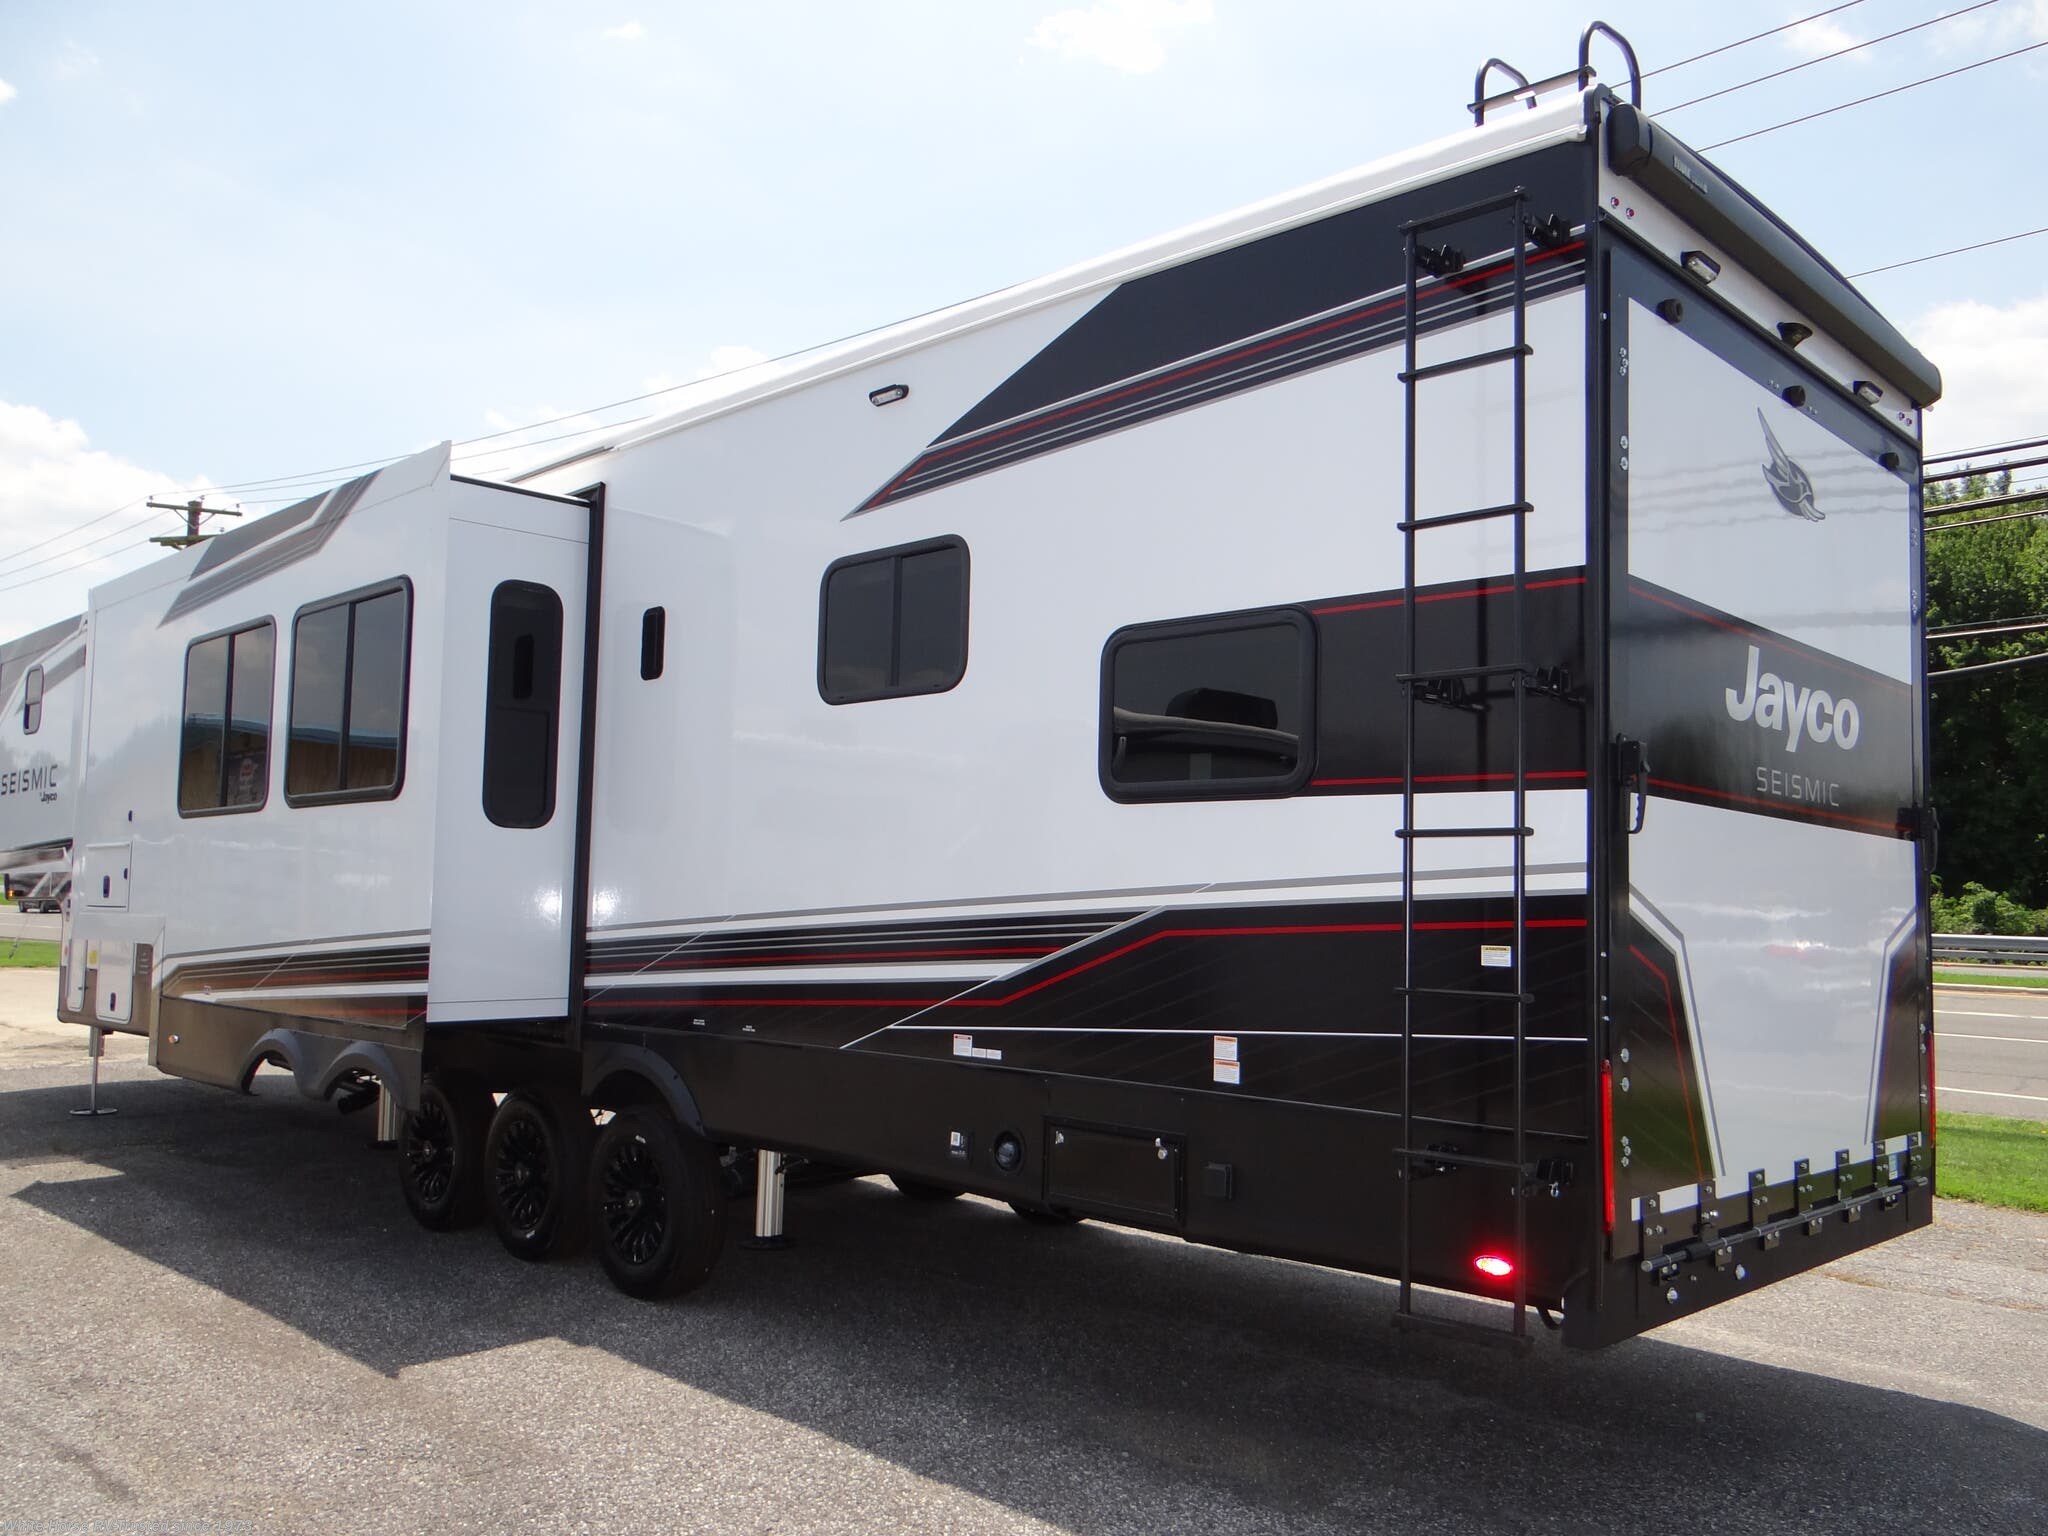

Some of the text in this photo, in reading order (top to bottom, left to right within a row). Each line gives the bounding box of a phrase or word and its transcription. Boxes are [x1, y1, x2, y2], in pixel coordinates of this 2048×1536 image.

[1725, 644, 1860, 753] Jayco
[0, 764, 58, 795] SEISMIC
[1756, 766, 1840, 807] SEISMIC
